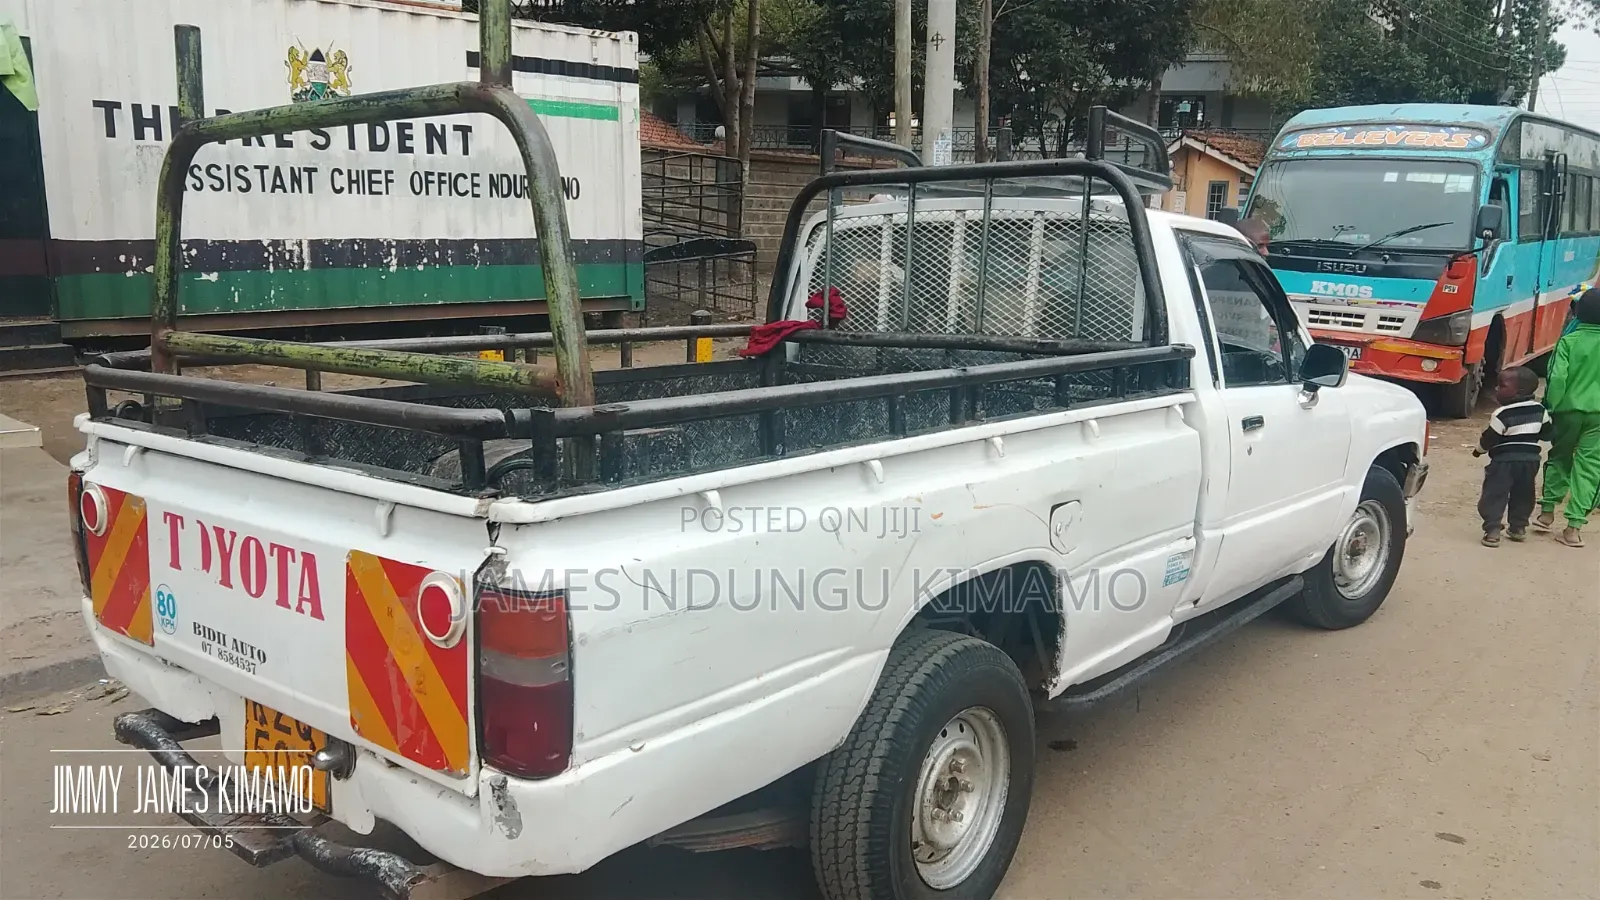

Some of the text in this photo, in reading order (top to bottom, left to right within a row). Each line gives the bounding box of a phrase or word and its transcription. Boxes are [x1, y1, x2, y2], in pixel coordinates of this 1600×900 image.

[215, 109, 473, 156] SIDENT
[1297, 131, 1471, 148] BELIEVERS
[183, 163, 318, 194] SSISTANT
[330, 167, 395, 196] CHIEF
[409, 170, 481, 198] OFFICE
[1317, 261, 1367, 274] ISUZU
[1310, 280, 1373, 299] KMOS
[1444, 284, 1456, 292] PSV
[157, 590, 176, 619] 80
[161, 617, 175, 629] KPH
[201, 641, 212, 656] 07
